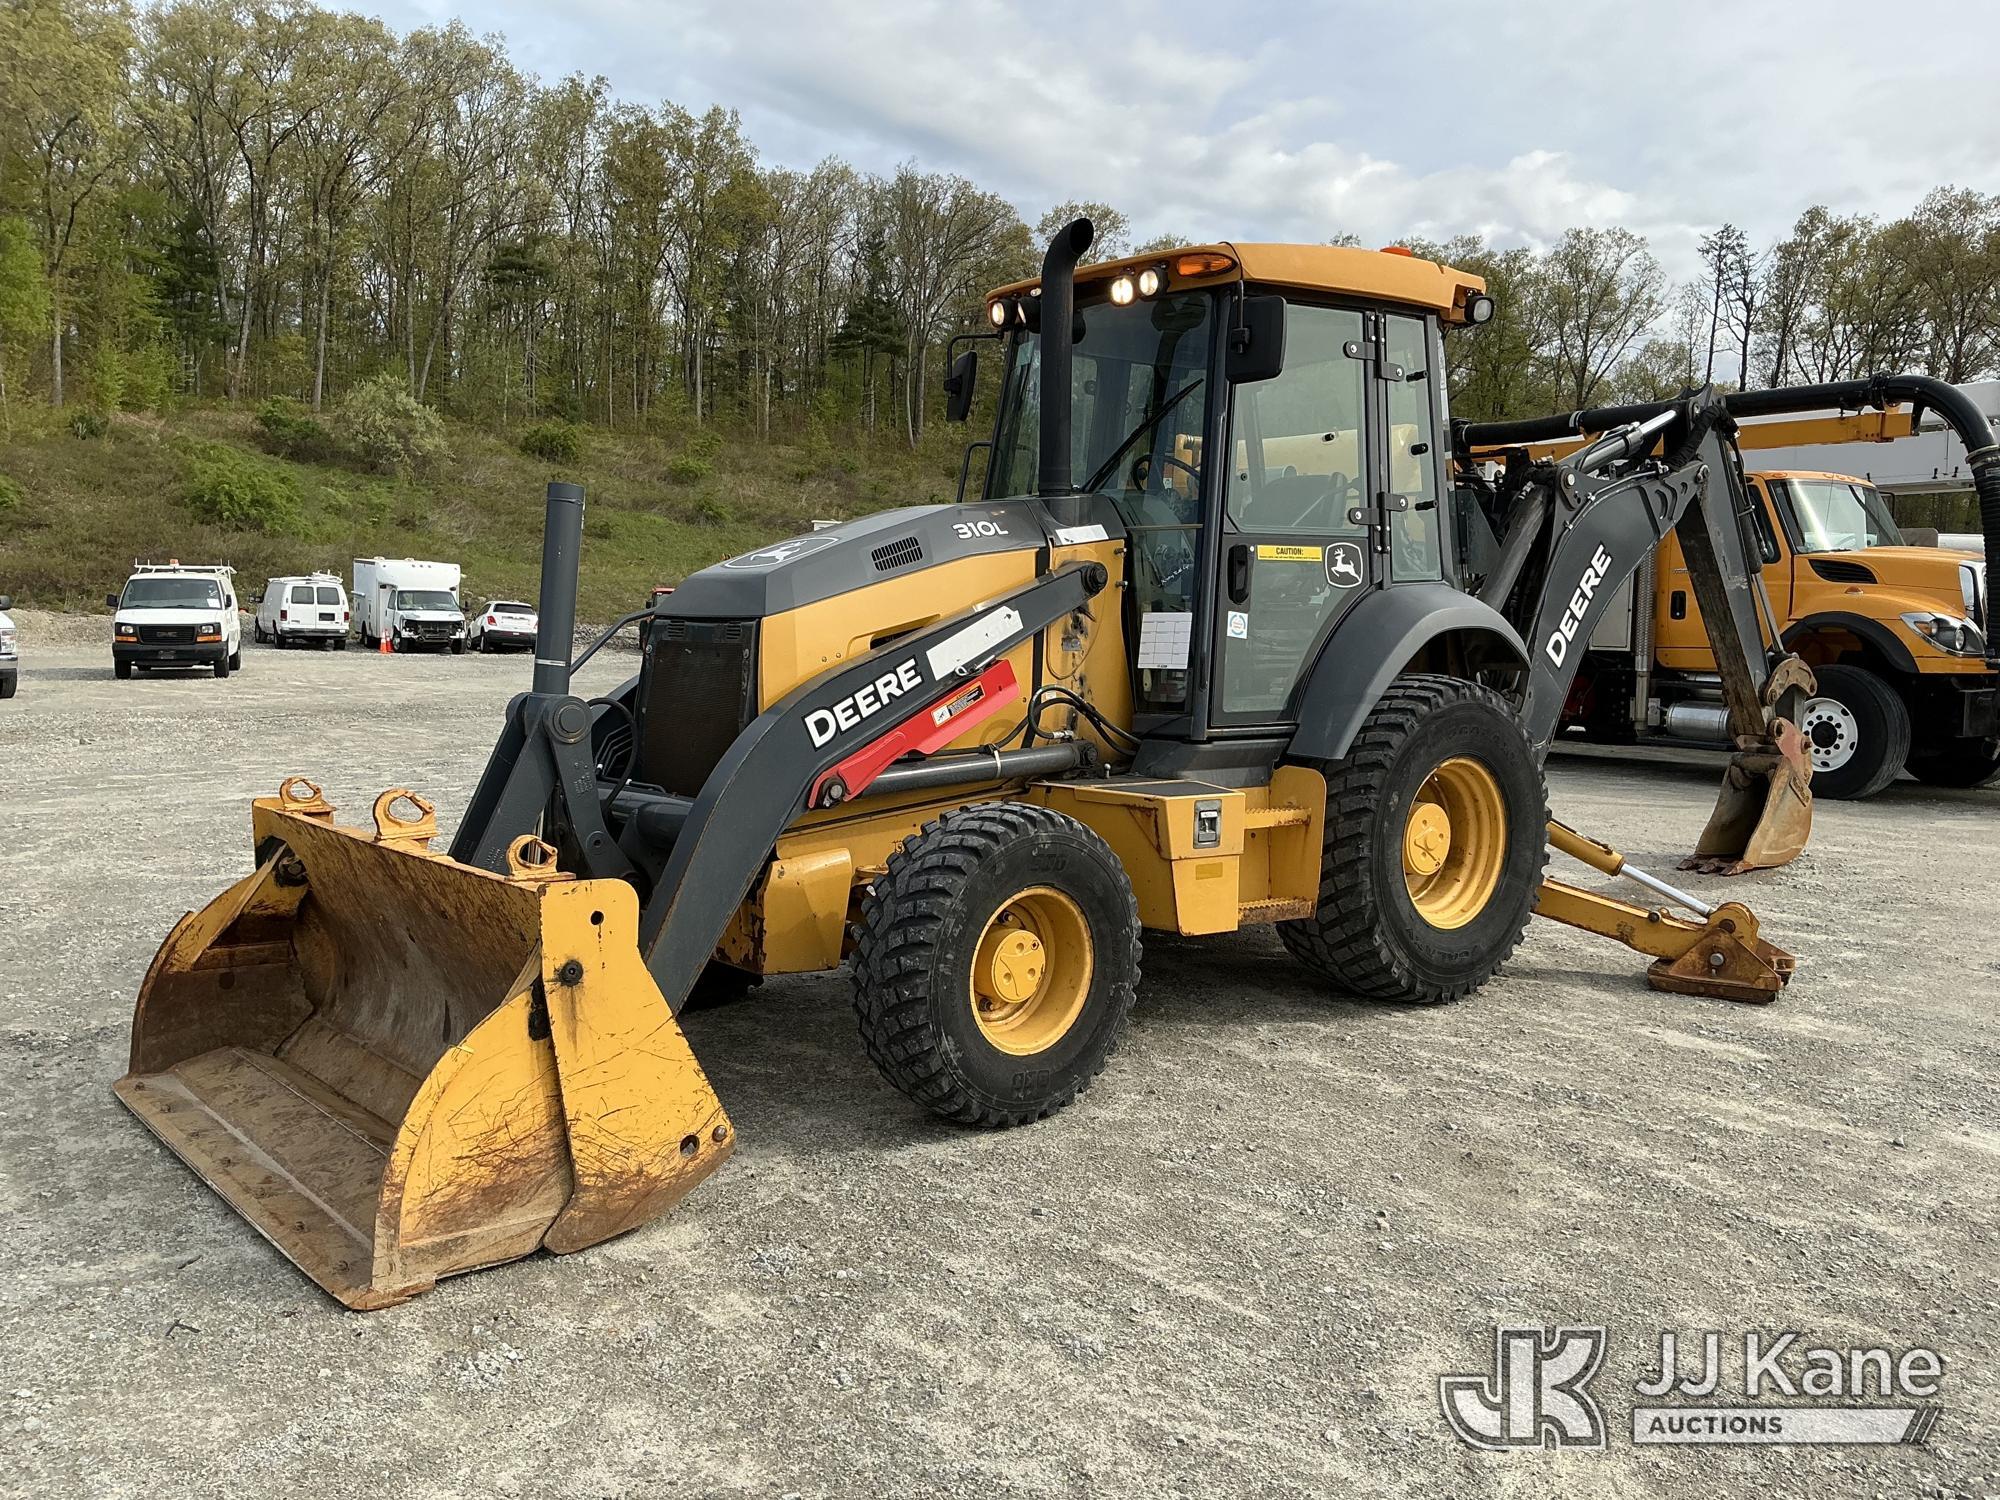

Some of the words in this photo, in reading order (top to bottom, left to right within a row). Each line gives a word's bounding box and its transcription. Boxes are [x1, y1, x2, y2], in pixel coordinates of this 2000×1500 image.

[952, 520, 1009, 540] 310L
[1275, 547, 1304, 556] CAUTION:
[1545, 543, 1612, 669] DEERE
[804, 657, 923, 748] DEERE
